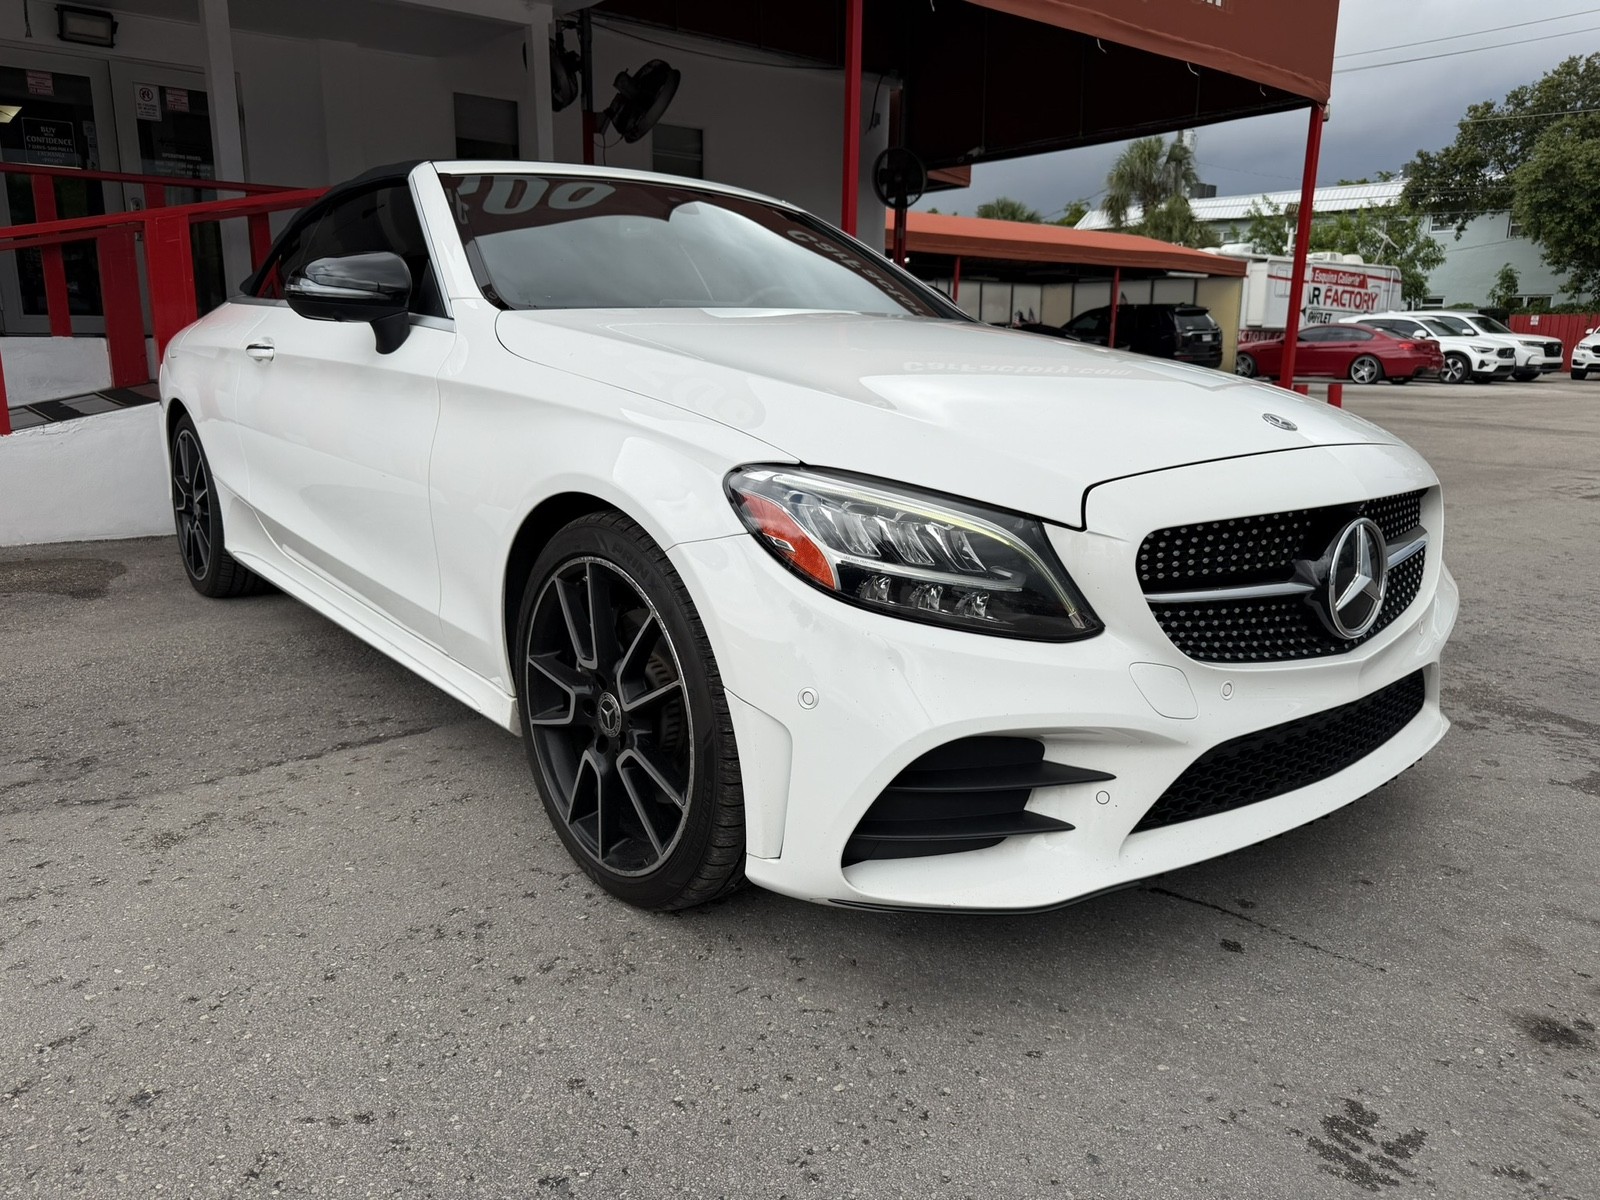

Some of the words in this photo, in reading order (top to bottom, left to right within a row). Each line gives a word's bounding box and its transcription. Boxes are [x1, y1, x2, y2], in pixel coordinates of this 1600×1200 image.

[40, 126, 56, 134] BUY
[26, 135, 73, 146] CONFIDENCE
[1314, 270, 1337, 284] Esquina
[1324, 288, 1378, 310] FACTORY
